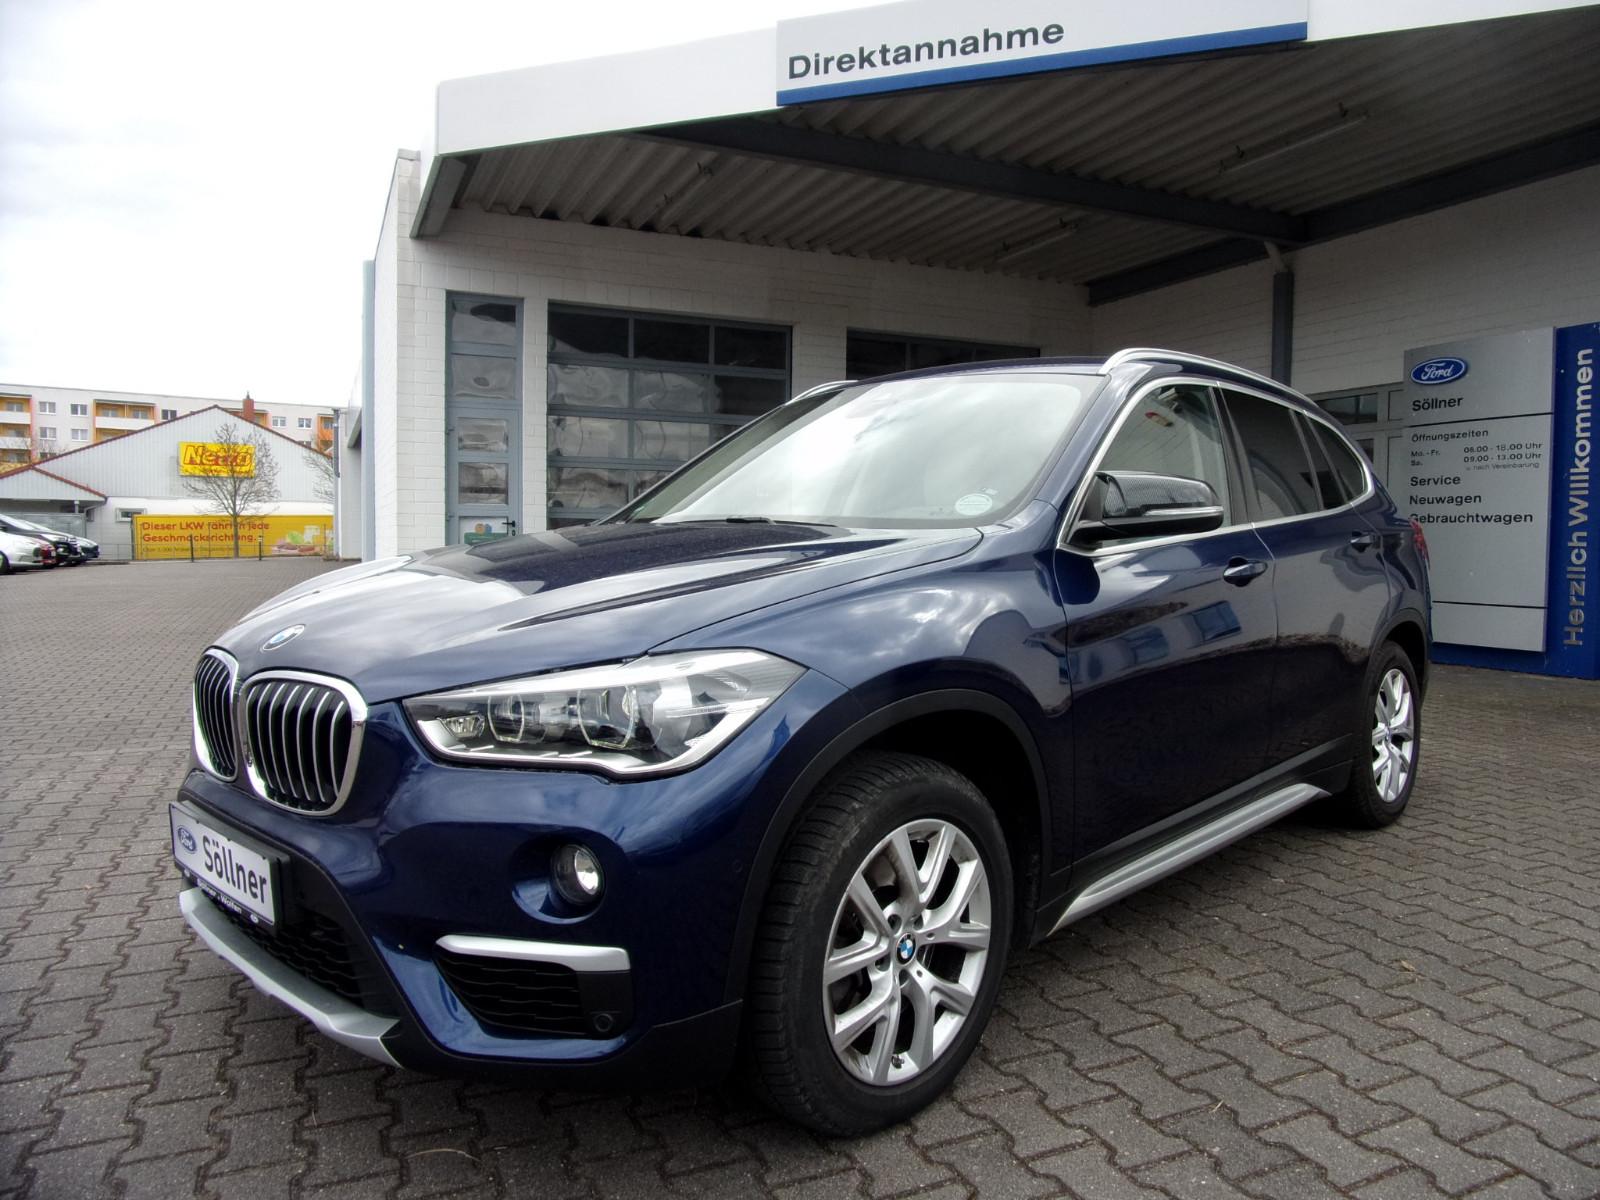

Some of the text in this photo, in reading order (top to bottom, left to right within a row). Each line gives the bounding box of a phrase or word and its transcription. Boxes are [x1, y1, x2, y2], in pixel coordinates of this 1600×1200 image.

[788, 23, 1064, 79] Direktannahme
[1420, 361, 1453, 381] Ford
[1412, 397, 1464, 412] Söllner
[1411, 429, 1489, 443] Öffnungszeiten
[1525, 442, 1543, 450] Uhr
[1463, 454, 1489, 463] 09.00
[1525, 452, 1542, 460] Uhr
[1491, 462, 1540, 471] Vereinbarung
[1410, 475, 1461, 487] Service
[1409, 495, 1482, 507] Neuwagen
[1563, 348, 1593, 646] Herzlich Willkommen
[142, 521, 177, 531] Dieser
[179, 521, 205, 530] LKW
[248, 521, 270, 531] jede
[202, 835, 267, 904] Söllner
